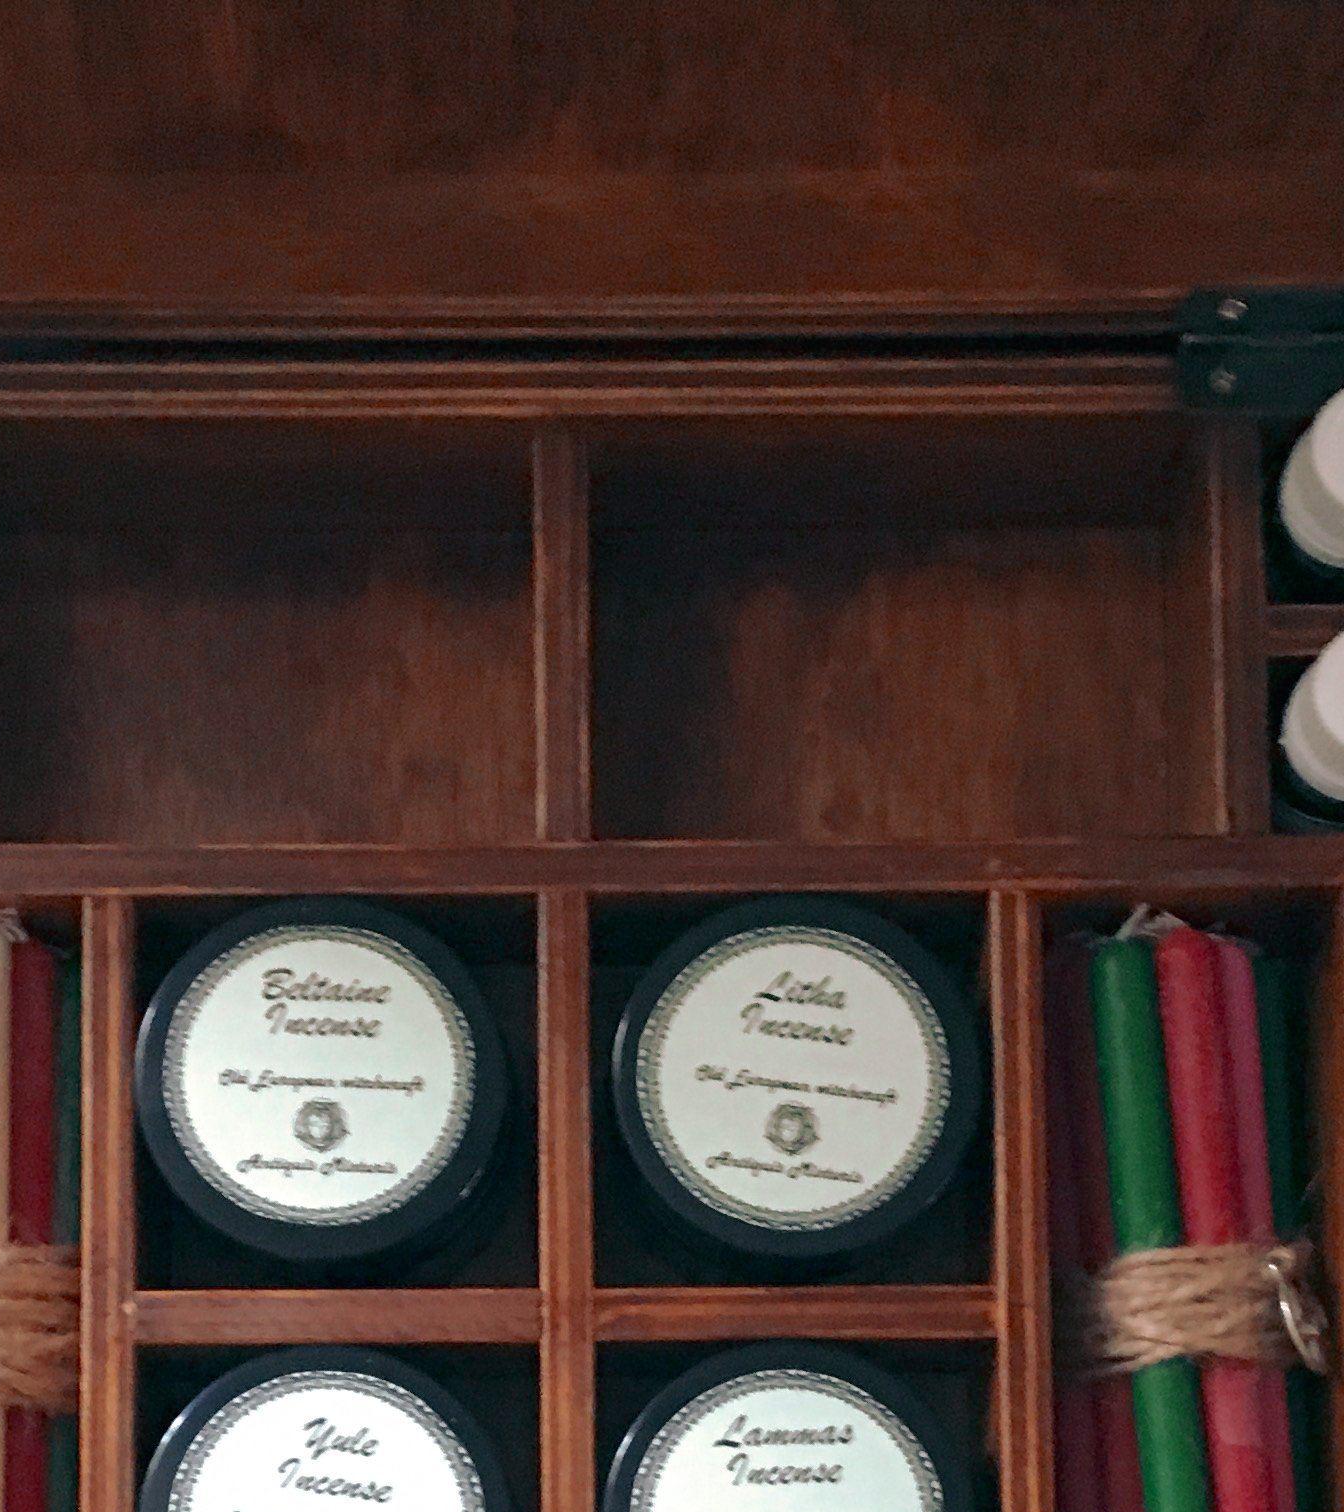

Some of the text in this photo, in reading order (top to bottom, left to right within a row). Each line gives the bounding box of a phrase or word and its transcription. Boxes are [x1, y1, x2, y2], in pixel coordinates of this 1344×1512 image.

[304, 1417, 379, 1460] Yule
[713, 1414, 853, 1447] Lammas
[278, 1458, 392, 1503] Incense
[726, 1452, 843, 1486] Incense
